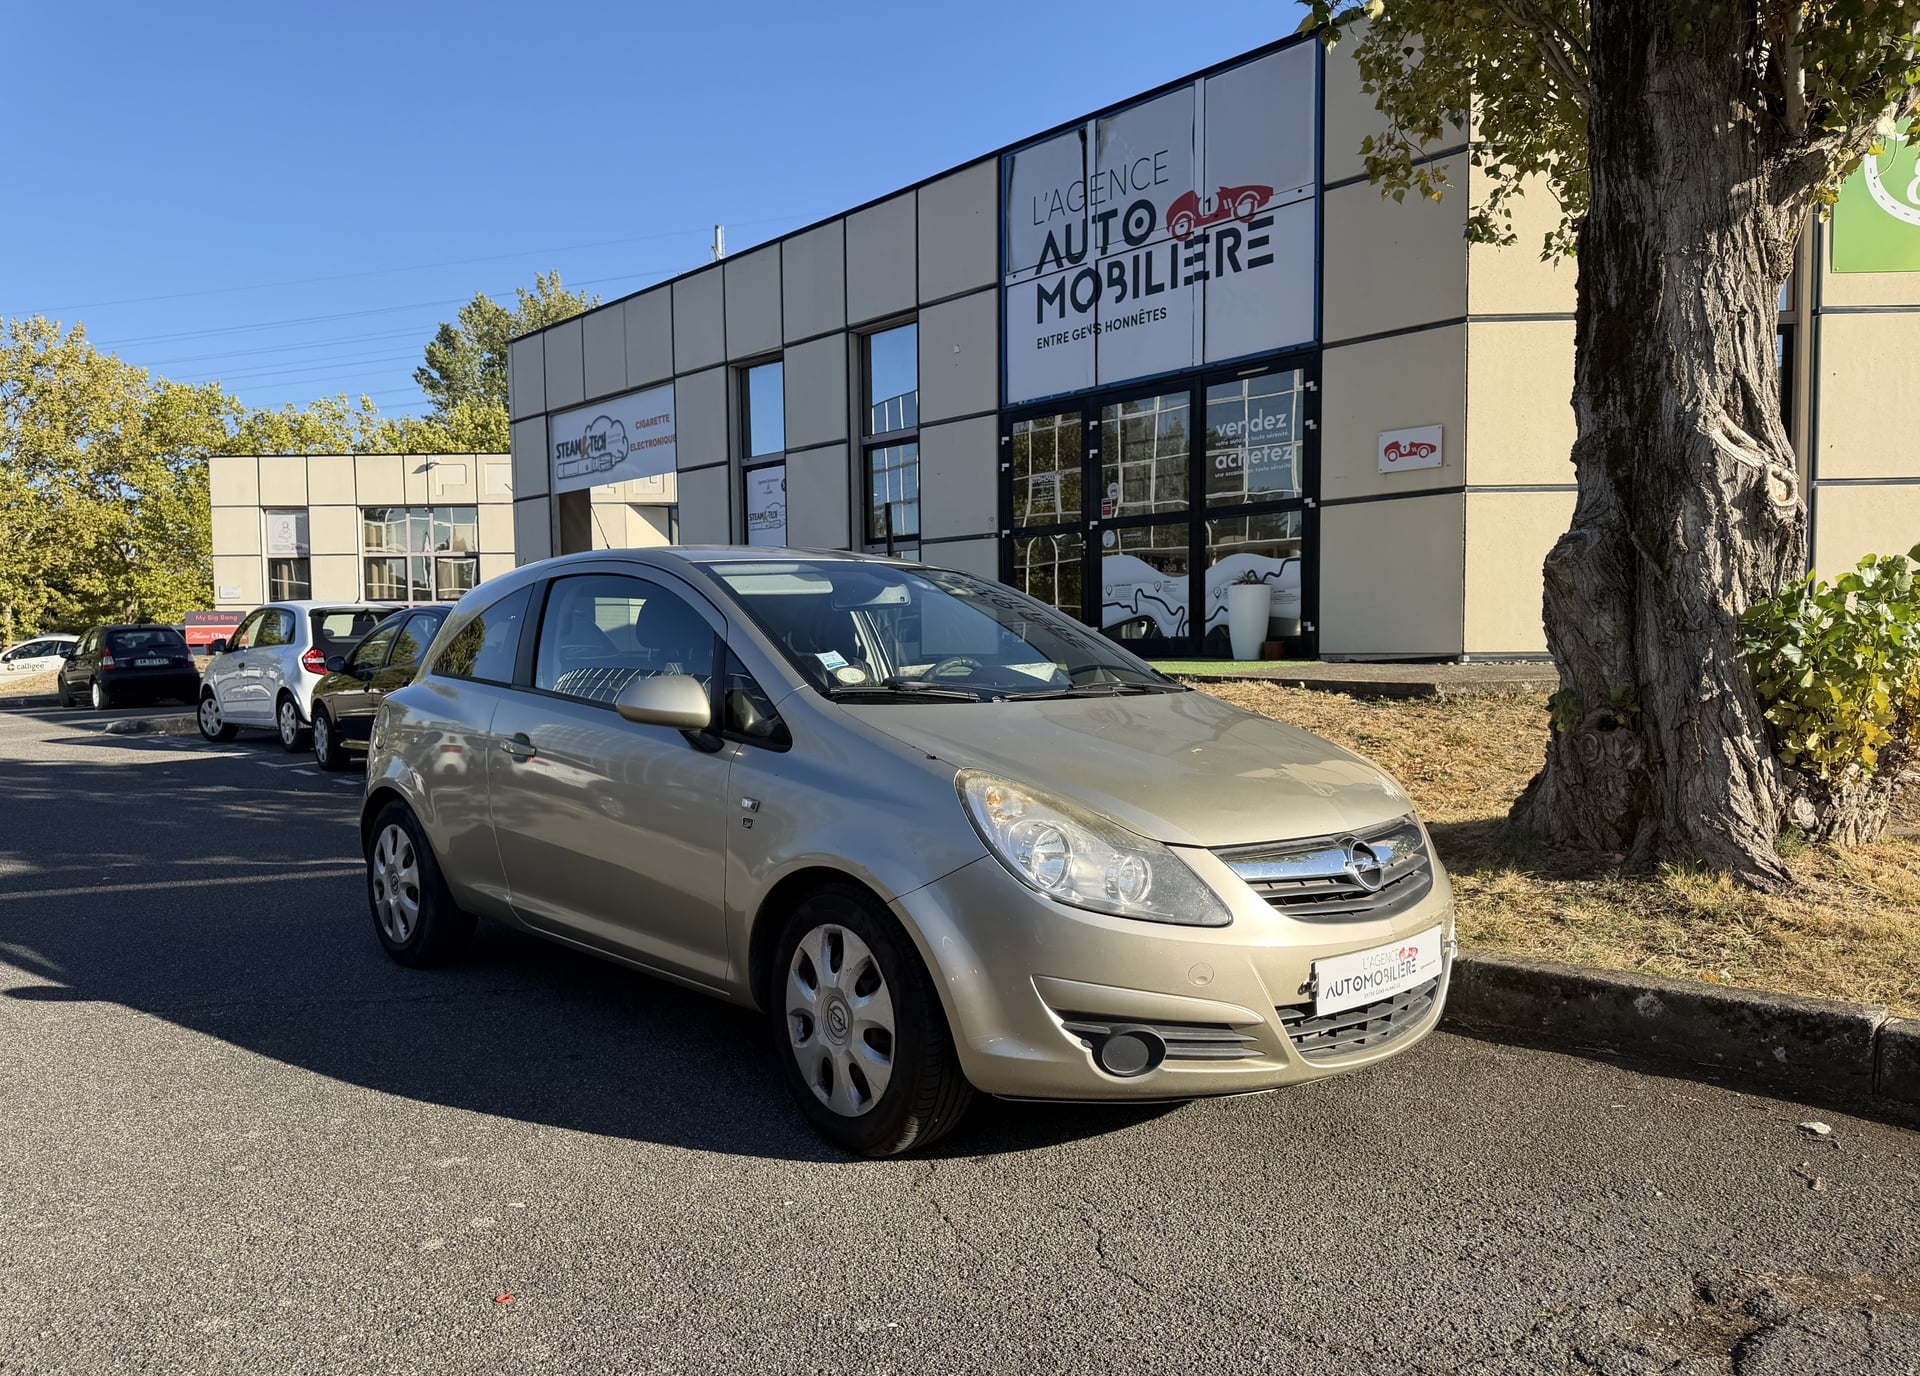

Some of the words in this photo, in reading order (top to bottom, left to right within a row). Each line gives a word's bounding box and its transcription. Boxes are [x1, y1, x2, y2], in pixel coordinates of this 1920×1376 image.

[1033, 149, 1168, 226] L'AGENCE
[1035, 199, 1157, 276] AUTO
[1037, 331, 1069, 349] ENTRE
[1105, 307, 1167, 333] HONNÊTES
[635, 413, 671, 430] CIGARETTE
[1216, 408, 1287, 437] vendez
[630, 433, 677, 452] ELECTRONIQUE
[1215, 444, 1293, 469] achetez
[207, 614, 219, 622] Big
[220, 614, 238, 622] Bang
